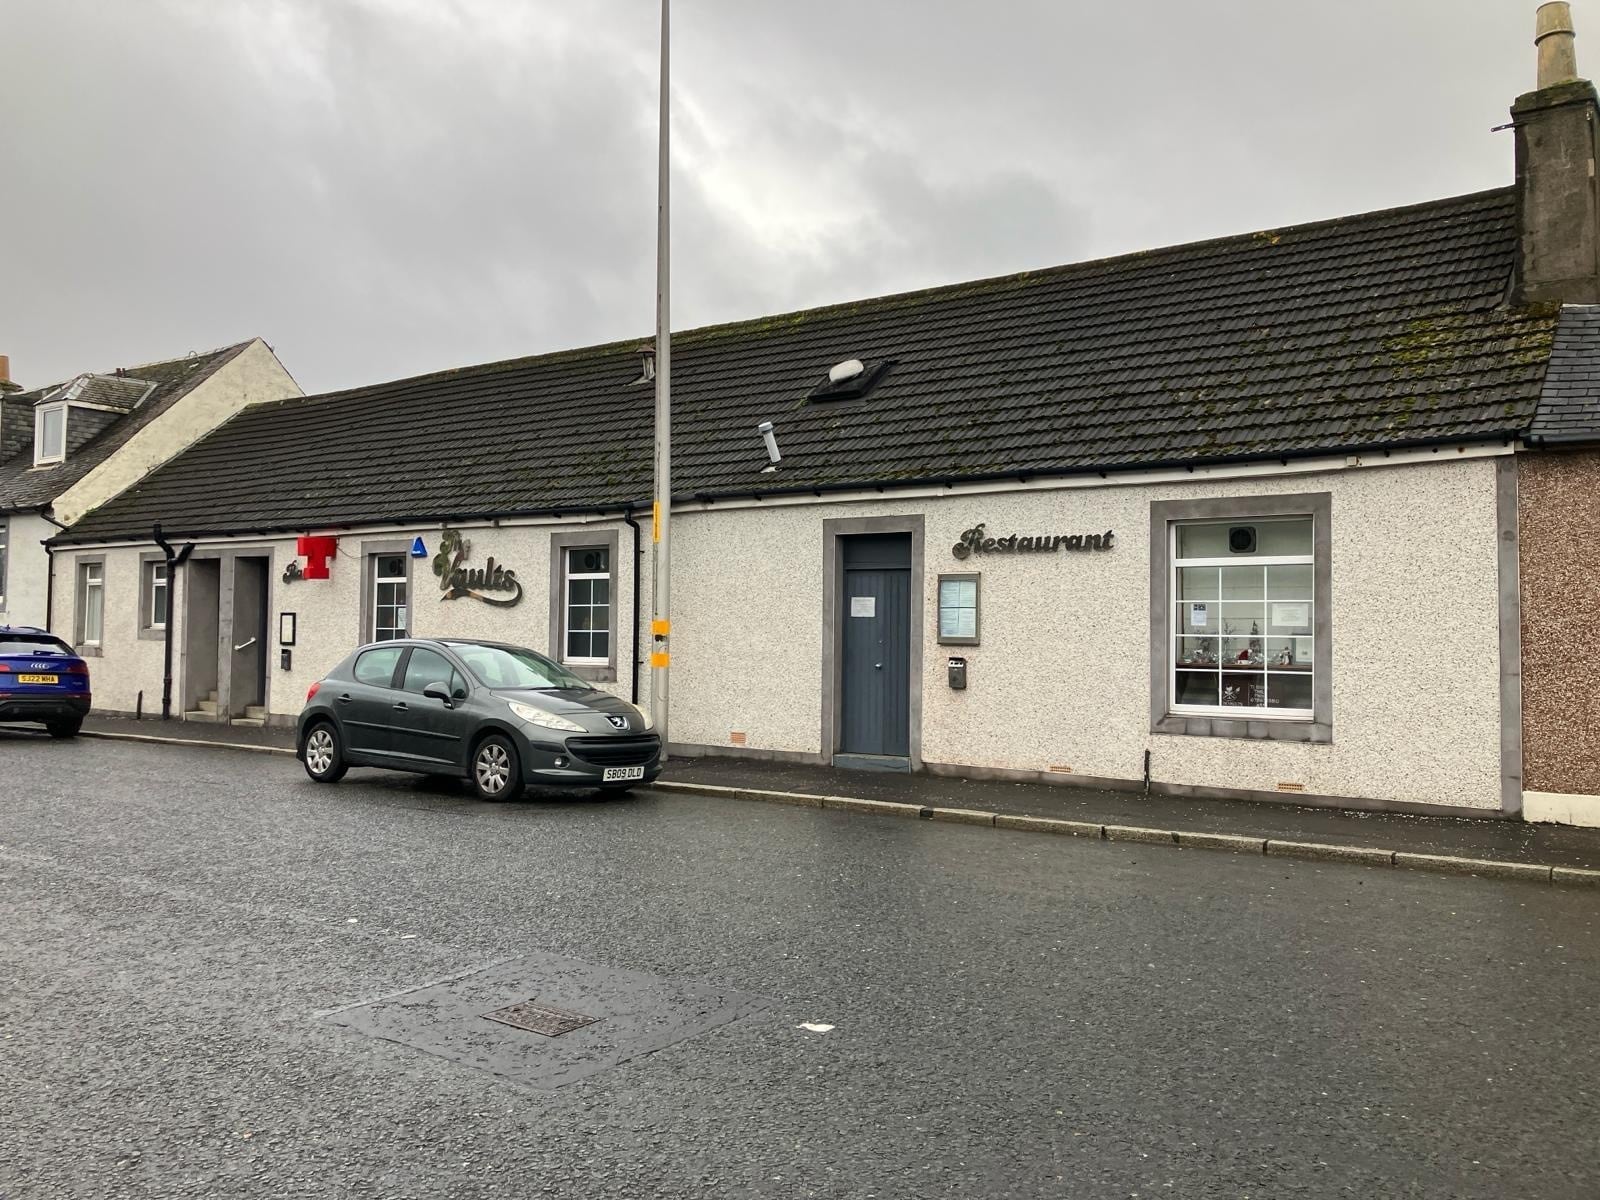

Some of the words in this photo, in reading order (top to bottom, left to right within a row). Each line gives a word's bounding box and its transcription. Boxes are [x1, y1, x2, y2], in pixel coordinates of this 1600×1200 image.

[297, 536, 337, 580] T
[952, 523, 1115, 559] Restaurant
[432, 530, 522, 605] Vaults
[606, 769, 627, 779] SB09
